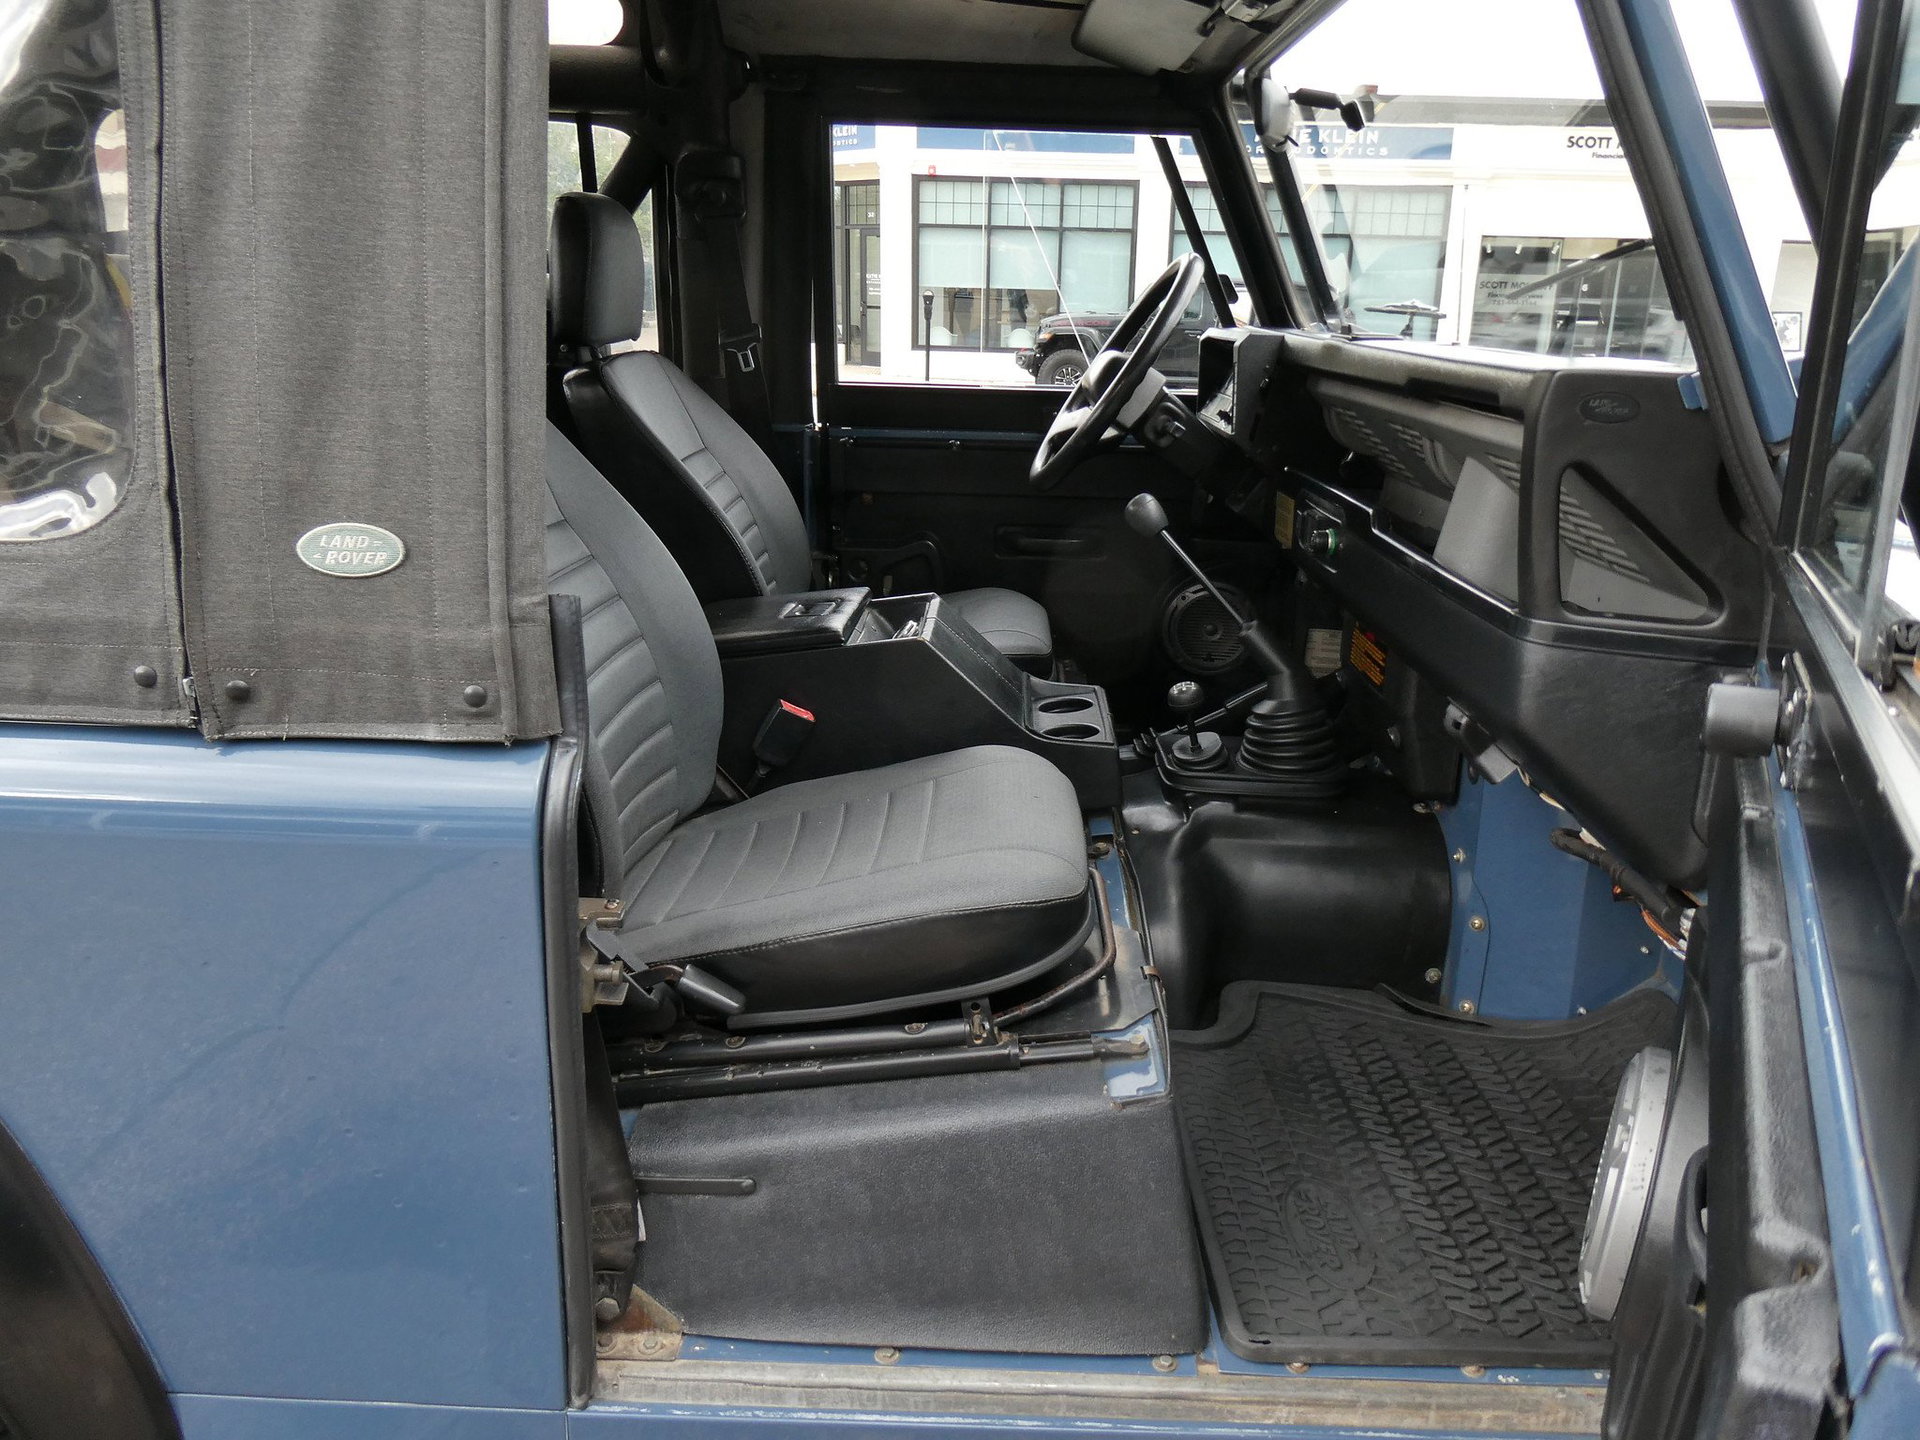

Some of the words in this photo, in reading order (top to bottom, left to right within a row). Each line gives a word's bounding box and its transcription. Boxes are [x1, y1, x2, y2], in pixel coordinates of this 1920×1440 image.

[1318, 128, 1379, 144] KLEIN
[1566, 135, 1613, 149] SCOTT
[1591, 151, 1626, 159] Financia
[319, 534, 369, 549] LAND
[325, 550, 388, 565] ROVER
